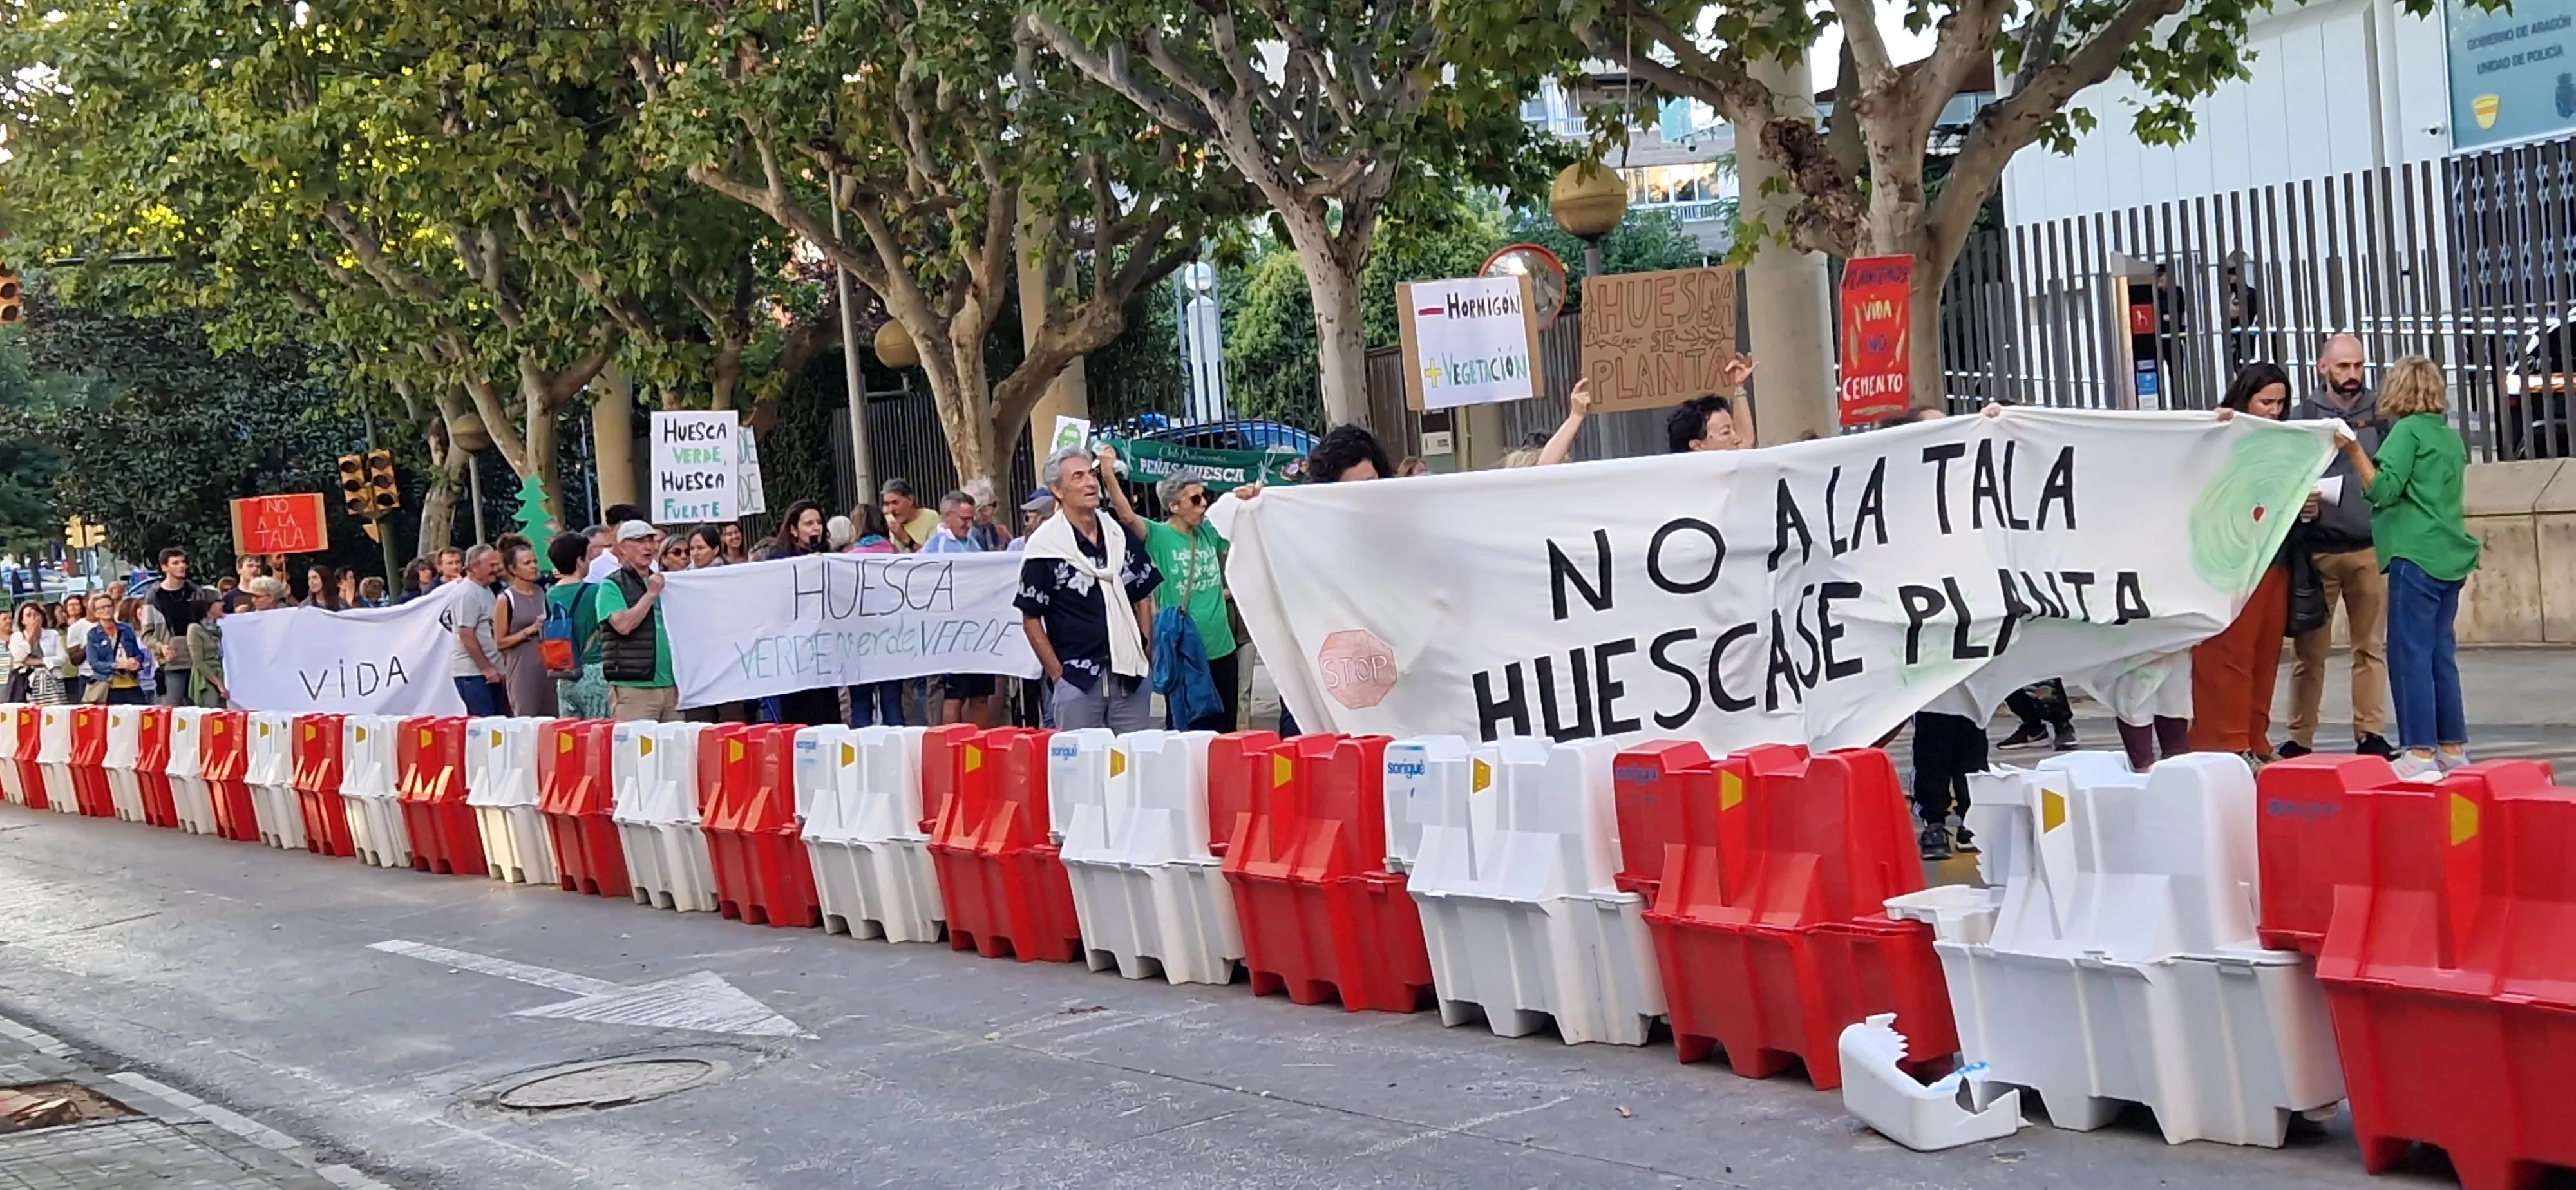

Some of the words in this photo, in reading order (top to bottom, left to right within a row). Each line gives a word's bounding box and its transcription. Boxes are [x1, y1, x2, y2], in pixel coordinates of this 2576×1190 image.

[2467, 28, 2515, 51] GOBIERNO
[2515, 24, 2528, 38] DE
[2477, 56, 2511, 75] UNIDAD
[2512, 53, 2525, 66] DE
[1597, 269, 1734, 334] HUESCA
[1650, 329, 1676, 353] SE
[1592, 346, 1731, 405] PLANTA
[1842, 373, 1904, 402] CEMENTO
[663, 418, 728, 444] HUESCA
[661, 471, 725, 493] HUESCA
[265, 498, 289, 513] NO
[258, 516, 267, 529] A
[278, 513, 296, 527] LA
[1546, 517, 1727, 622] NO
[1922, 437, 2077, 535] TALA
[255, 527, 306, 548] TALA
[793, 558, 955, 620] HUESCA
[1896, 568, 2152, 666] PLANTA
[921, 618, 1023, 657] VERDE
[299, 656, 409, 702] VIDA
[1321, 654, 1389, 689] STOP
